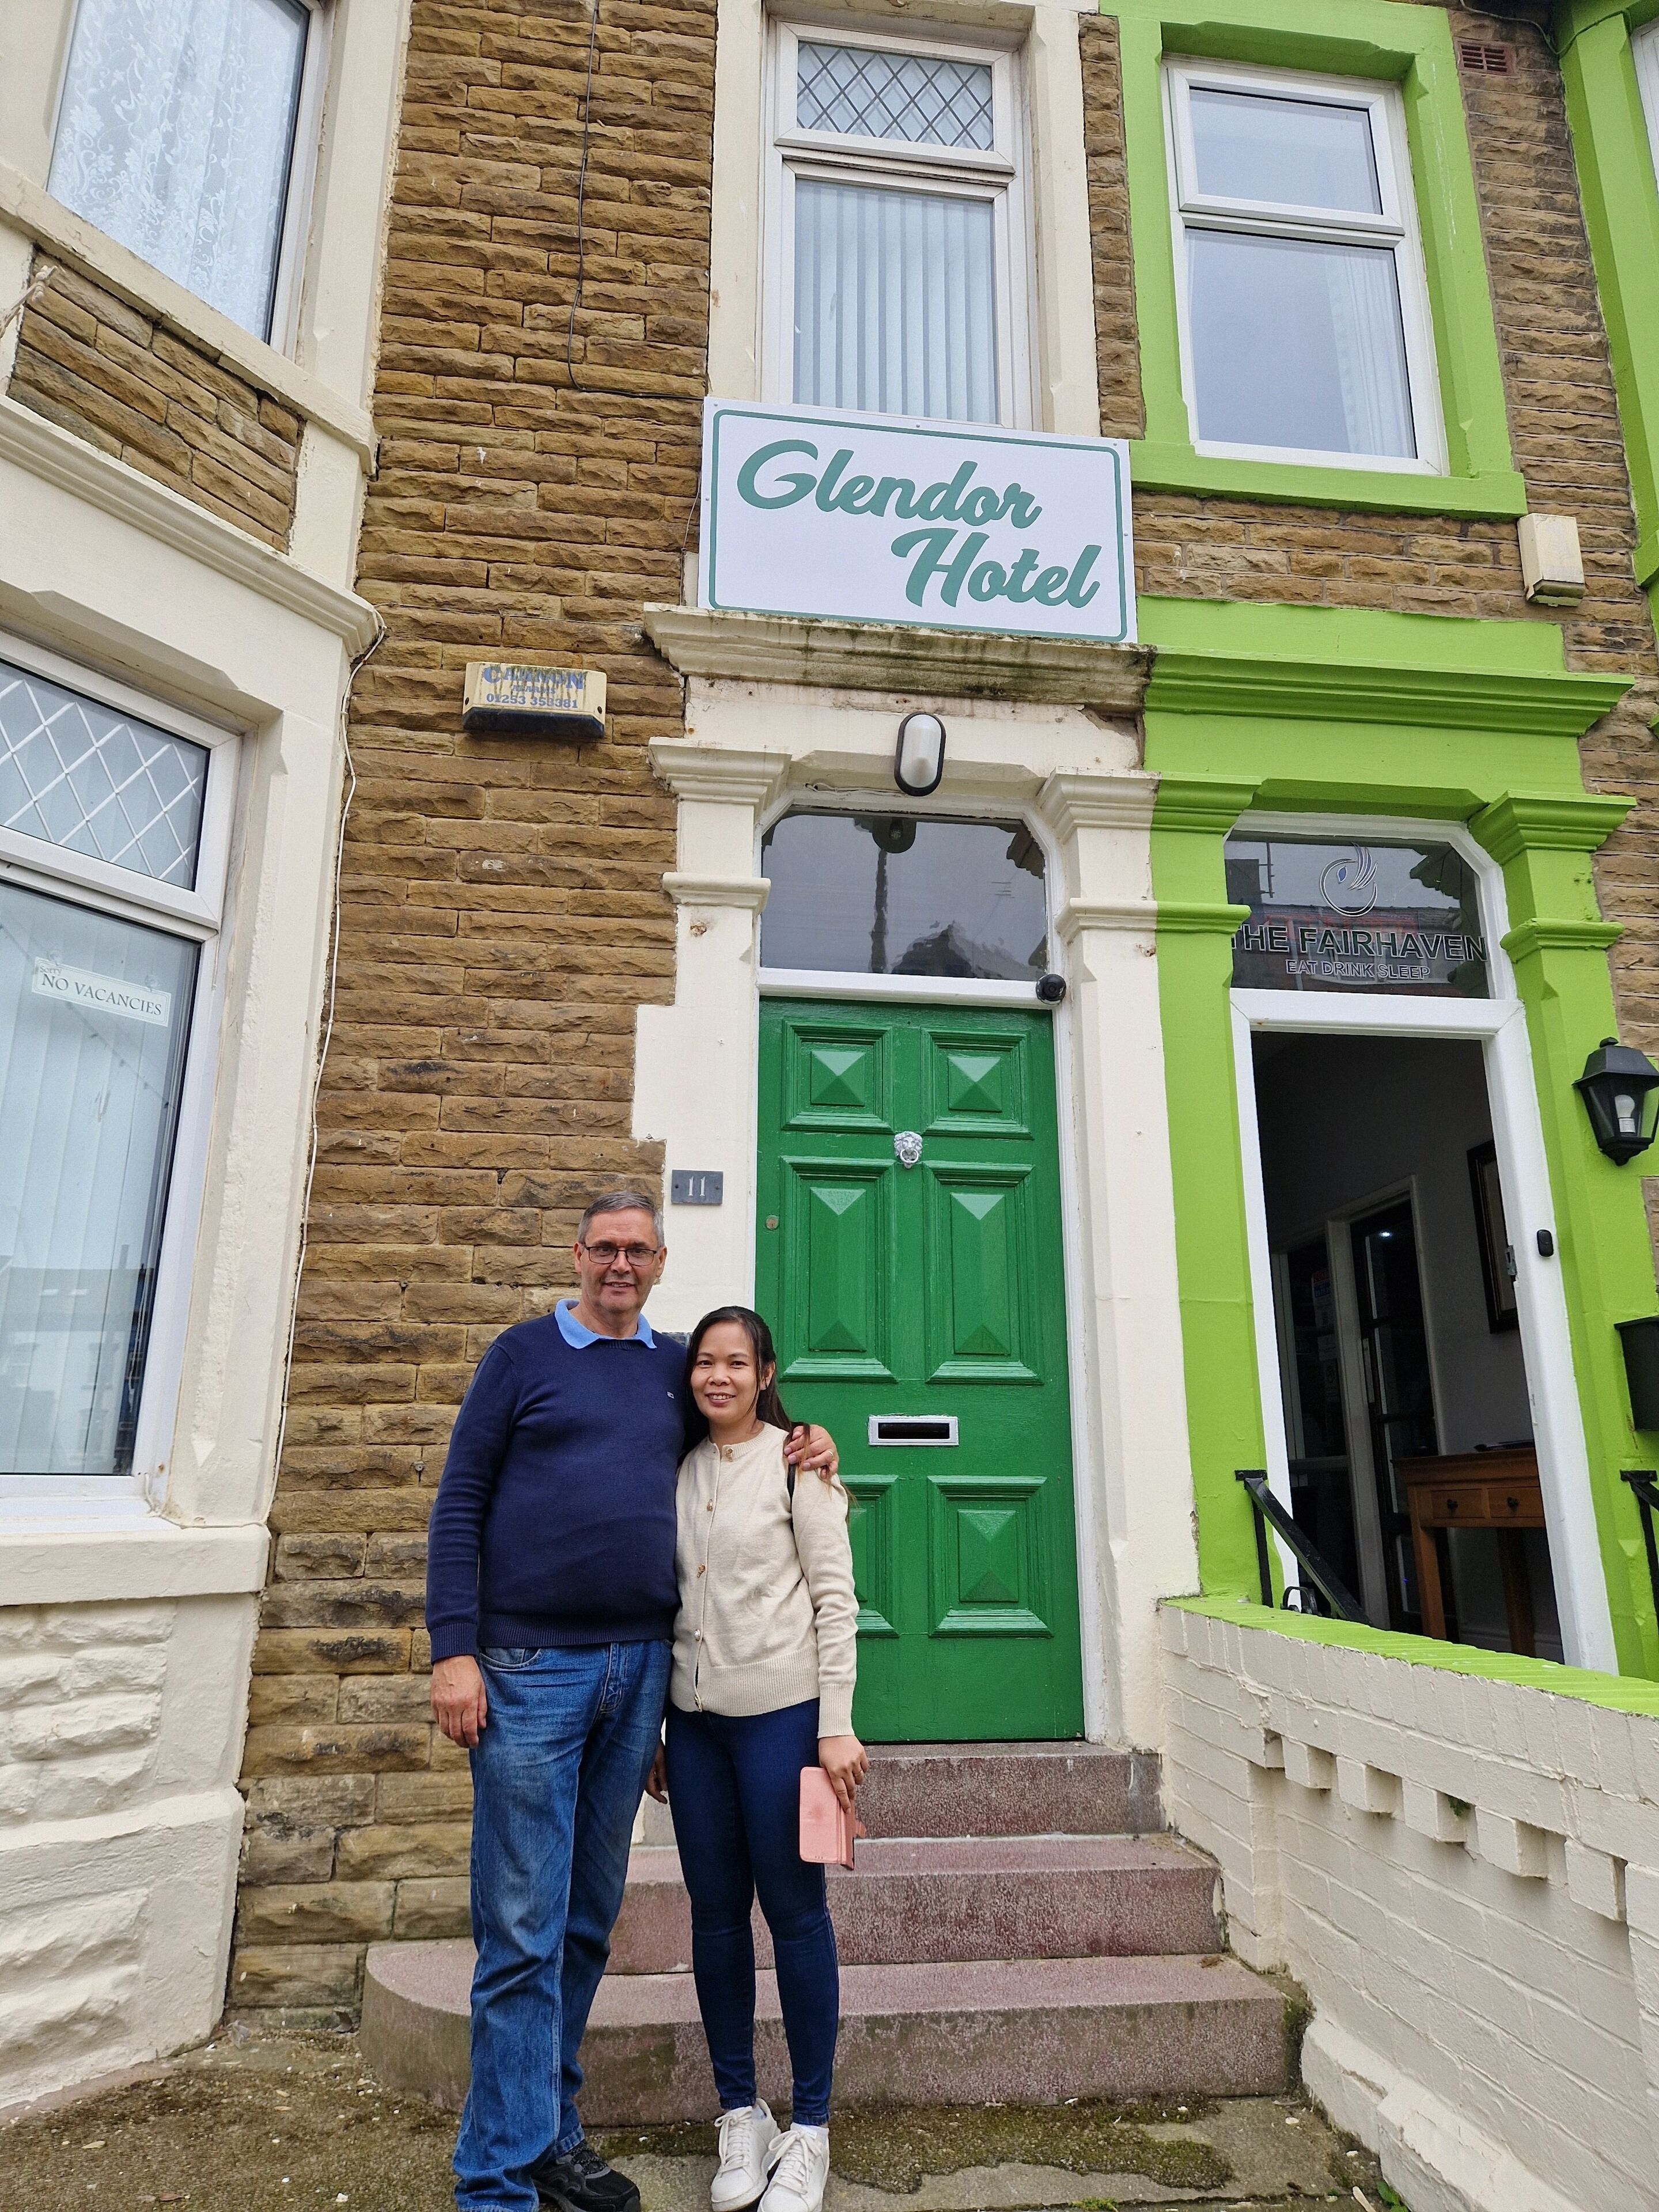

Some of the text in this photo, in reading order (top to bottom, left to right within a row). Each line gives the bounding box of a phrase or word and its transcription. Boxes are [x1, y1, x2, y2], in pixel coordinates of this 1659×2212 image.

[737, 439, 1043, 529] Glendor
[891, 527, 1102, 609] Hotel
[486, 693, 526, 705] 01253
[1300, 926, 1488, 962] FAIRHAVEN
[40, 965, 62, 977] Sorry
[1286, 959, 1430, 979] EAT DRINK SLEEP
[41, 974, 162, 1016] NO VACANCIES
[688, 1176, 706, 1196] 11
